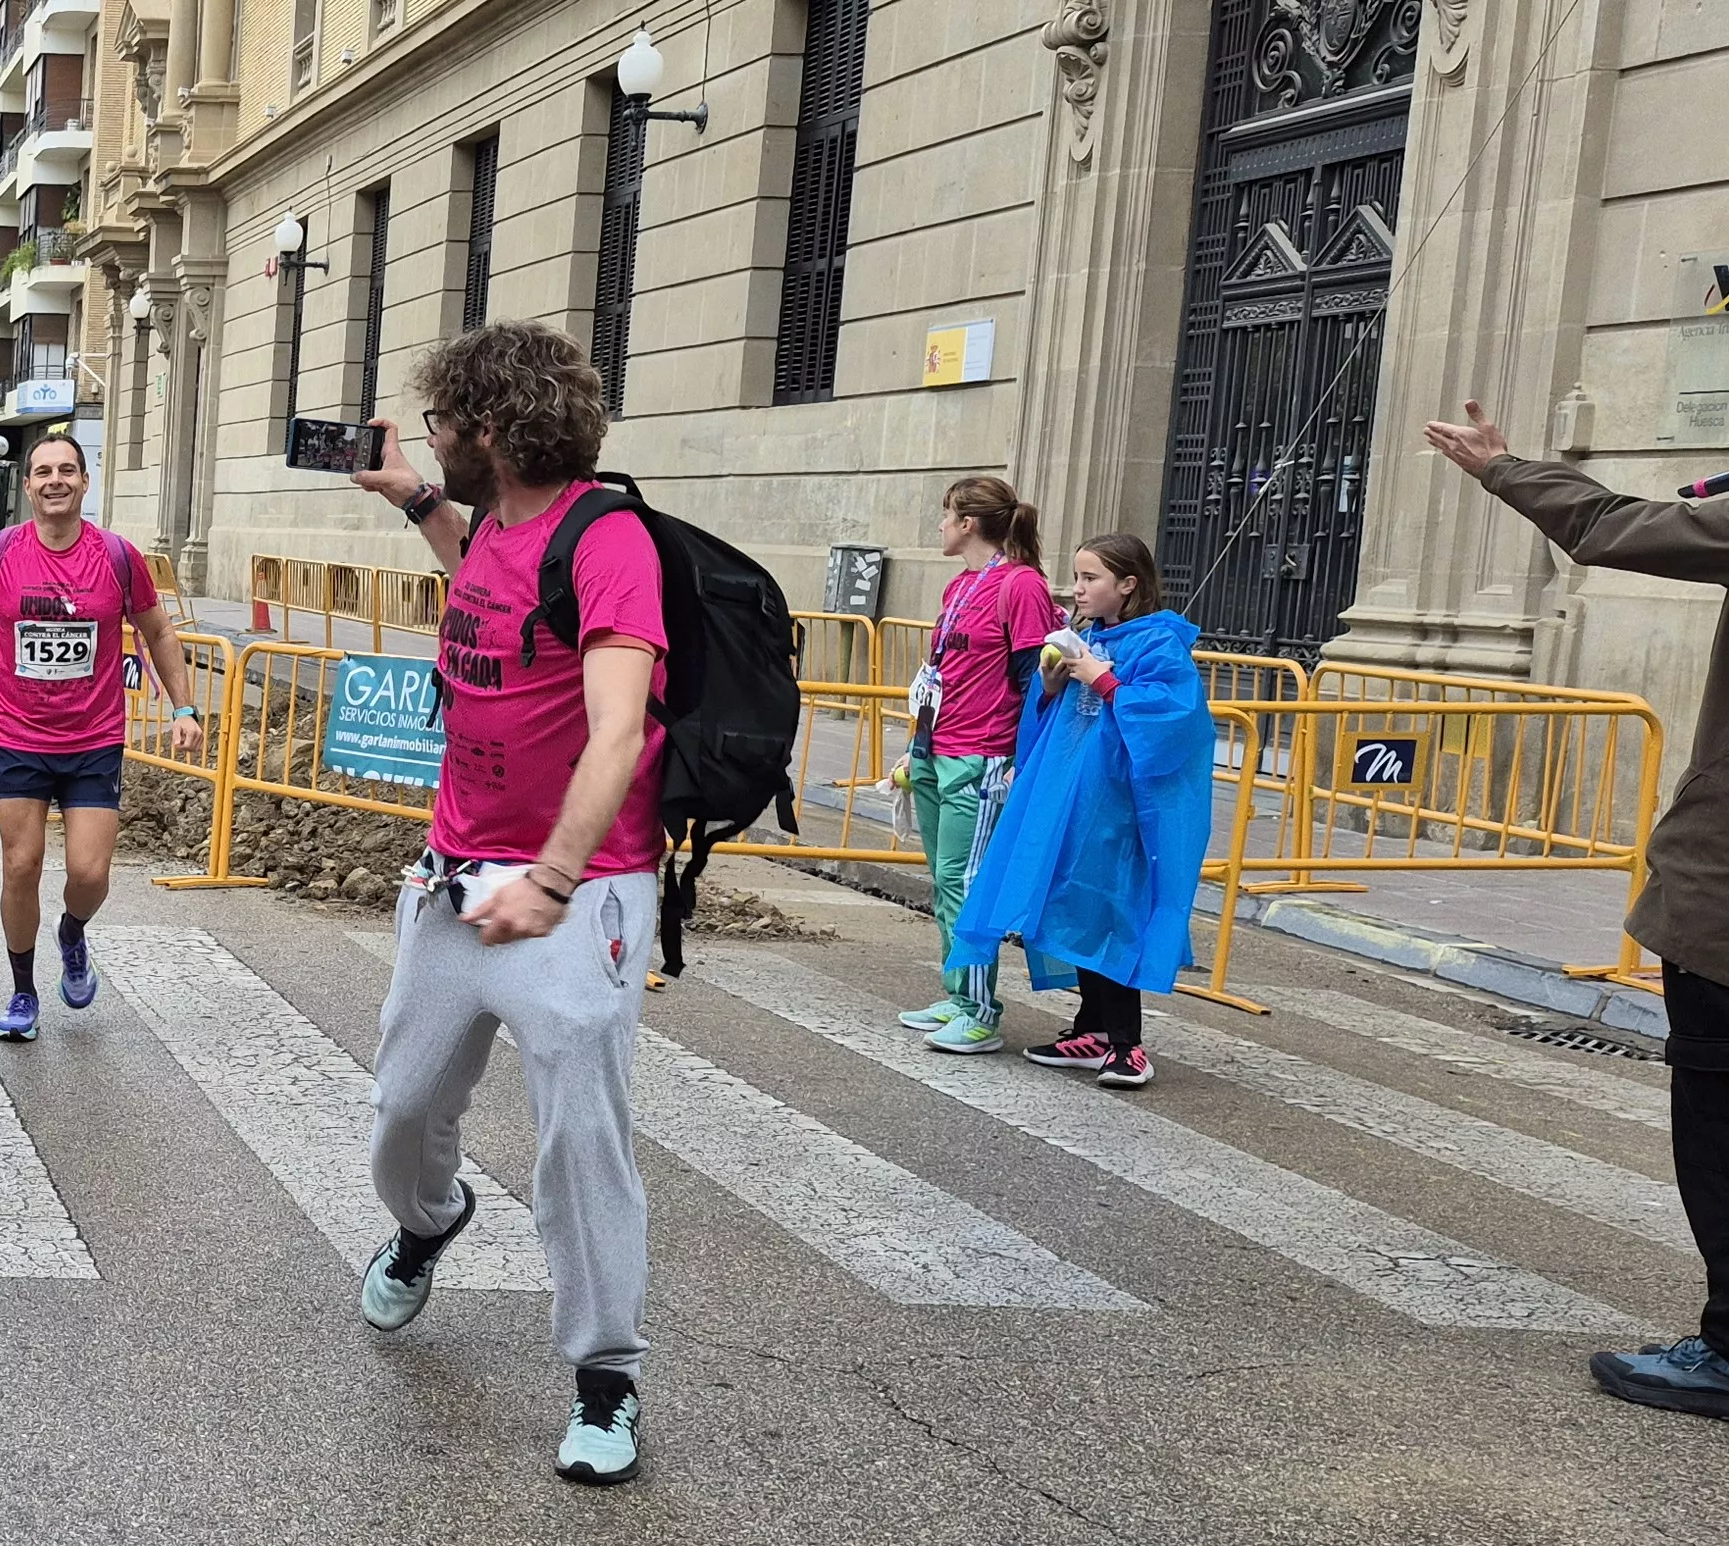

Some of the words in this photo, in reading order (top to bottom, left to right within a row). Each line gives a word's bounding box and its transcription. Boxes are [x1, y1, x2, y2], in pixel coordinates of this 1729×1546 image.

[1689, 414, 1725, 427] Huesca
[24, 641, 88, 662] 1529
[344, 665, 432, 714] GARL
[339, 706, 397, 728] SERVICIOS
[397, 714, 446, 734] INMOILI
